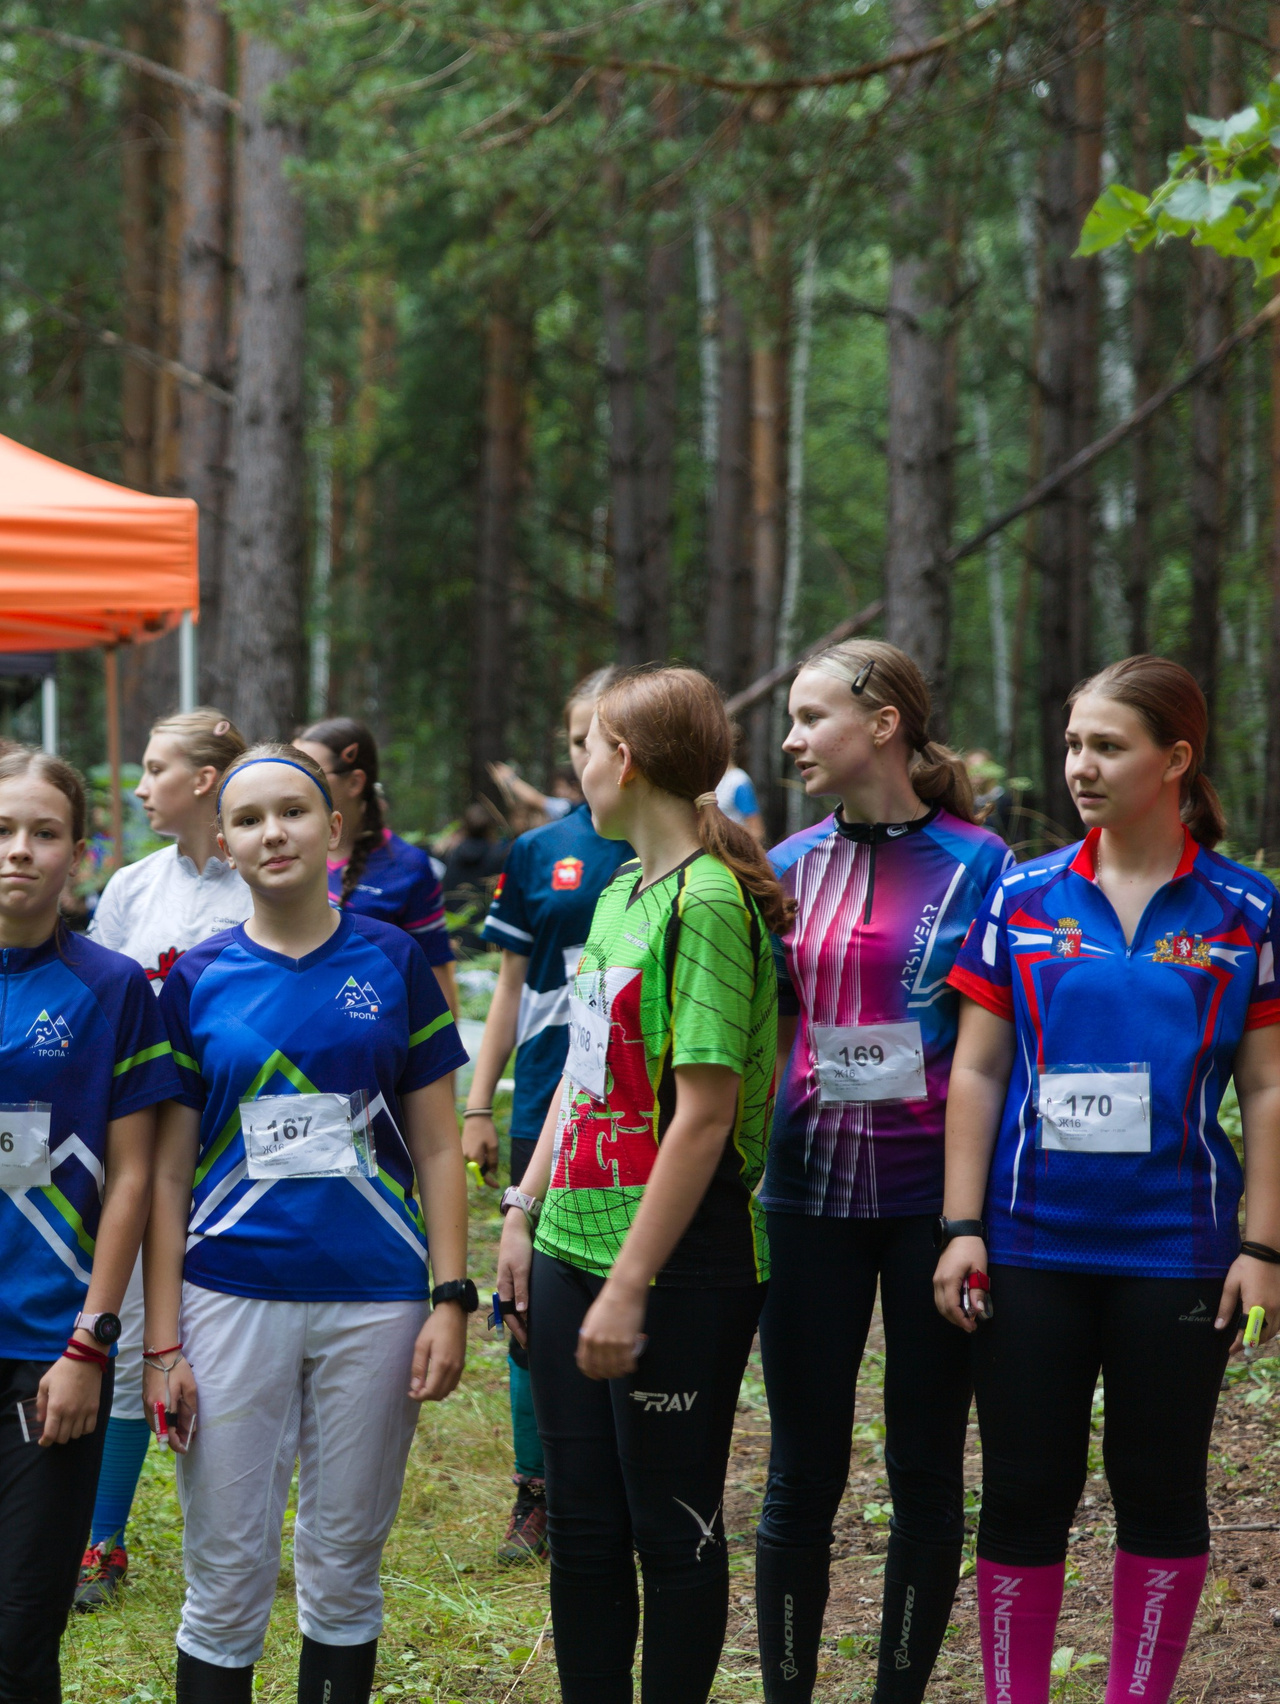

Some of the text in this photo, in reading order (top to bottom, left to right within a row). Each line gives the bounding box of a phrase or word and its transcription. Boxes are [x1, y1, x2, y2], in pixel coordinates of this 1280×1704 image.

[349, 1010, 376, 1020] ТРОПА
[38, 1049, 65, 1057] ТРОПА
[839, 1045, 884, 1067] 169
[834, 1069, 856, 1078] Ж16
[1066, 1094, 1112, 1117] 170
[267, 1115, 312, 1142] 167
[1059, 1118, 1081, 1128] Ж16
[262, 1143, 285, 1154] Ж16
[1178, 1314, 1212, 1322] DEMIX
[629, 1390, 698, 1412] RAY
[784, 1594, 794, 1658] NORD
[900, 1585, 916, 1649] NORD
[993, 1598, 1013, 1704] NORDSKI
[1128, 1591, 1167, 1696] NORDSKI
